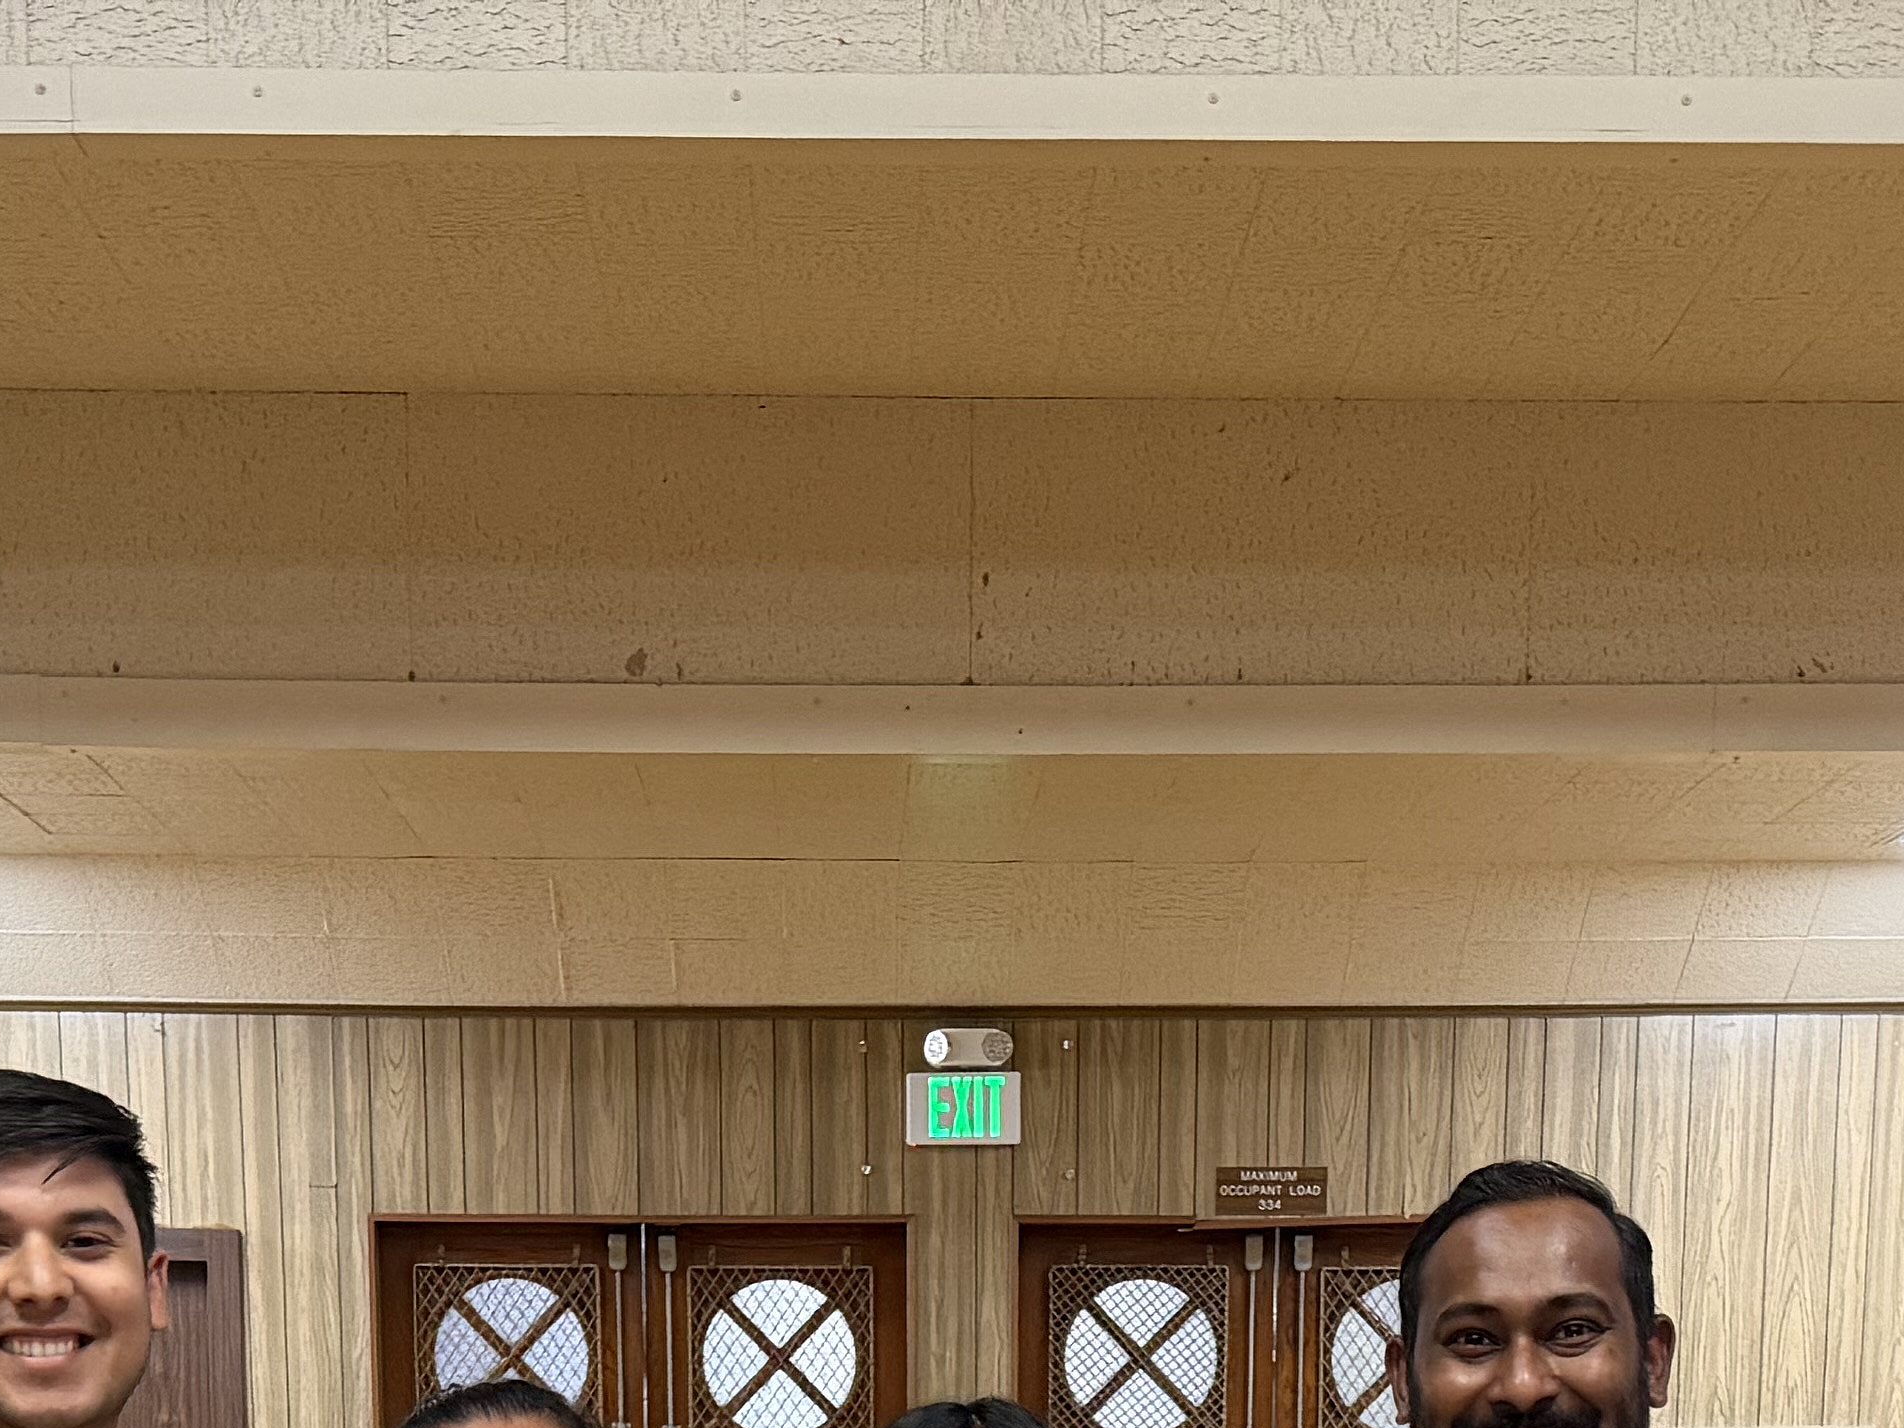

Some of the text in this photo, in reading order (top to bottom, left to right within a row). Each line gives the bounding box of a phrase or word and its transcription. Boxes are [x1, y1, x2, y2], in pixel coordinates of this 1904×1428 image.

[927, 1075, 1007, 1139] EXIT
[1240, 1170, 1298, 1181] MAXIMUM
[1219, 1184, 1322, 1196] OCCUPANT LOAD
[1258, 1199, 1282, 1211] 334
